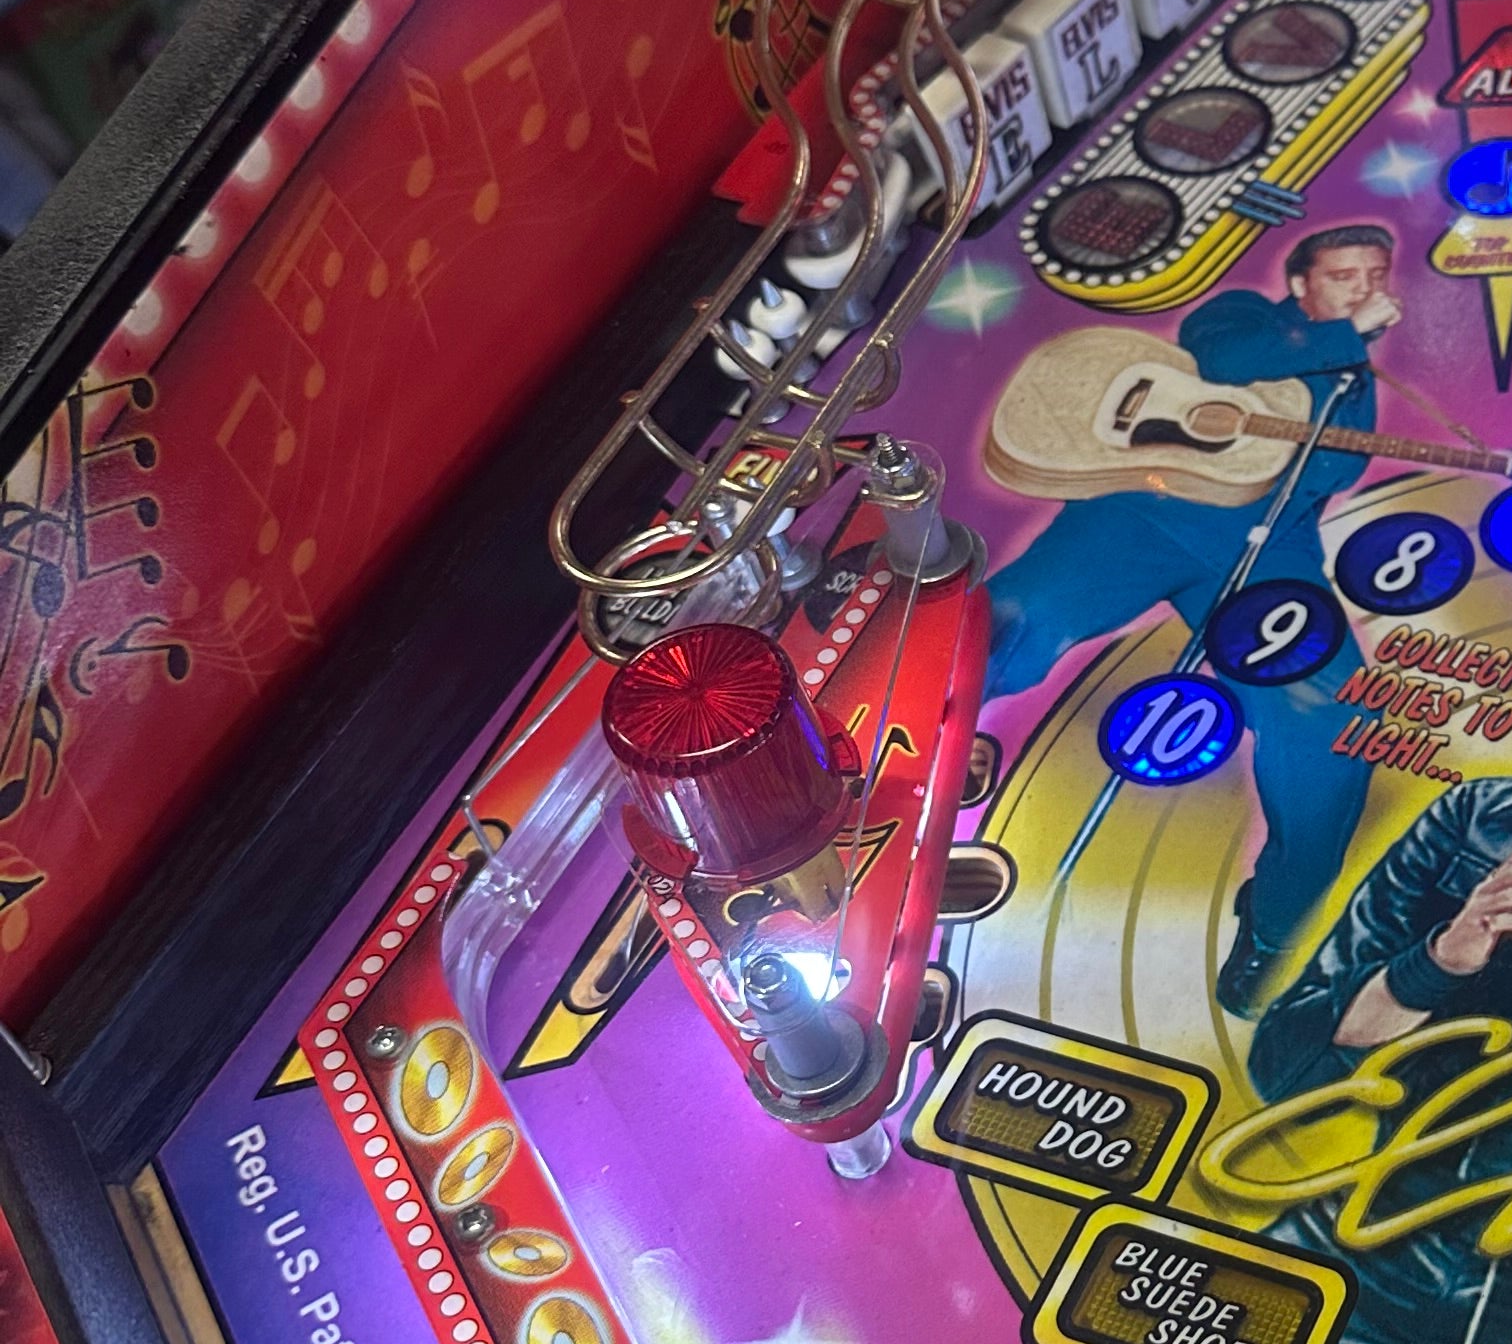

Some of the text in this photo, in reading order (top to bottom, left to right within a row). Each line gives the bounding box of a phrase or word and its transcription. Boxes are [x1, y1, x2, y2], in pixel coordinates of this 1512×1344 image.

[1374, 530, 1437, 592] 8
[1244, 599, 1310, 667] 9
[1122, 688, 1218, 765] 10
[1335, 666, 1463, 726] NOTES
[1330, 719, 1463, 787] LIGHT...
[978, 1062, 1131, 1125] HOUND
[1039, 1121, 1135, 1170] DOG
[226, 1124, 278, 1214] Reg.
[265, 1209, 321, 1295] U.S.
[1114, 1240, 1209, 1291] BLUE
[1121, 1275, 1241, 1331] SUEDE
